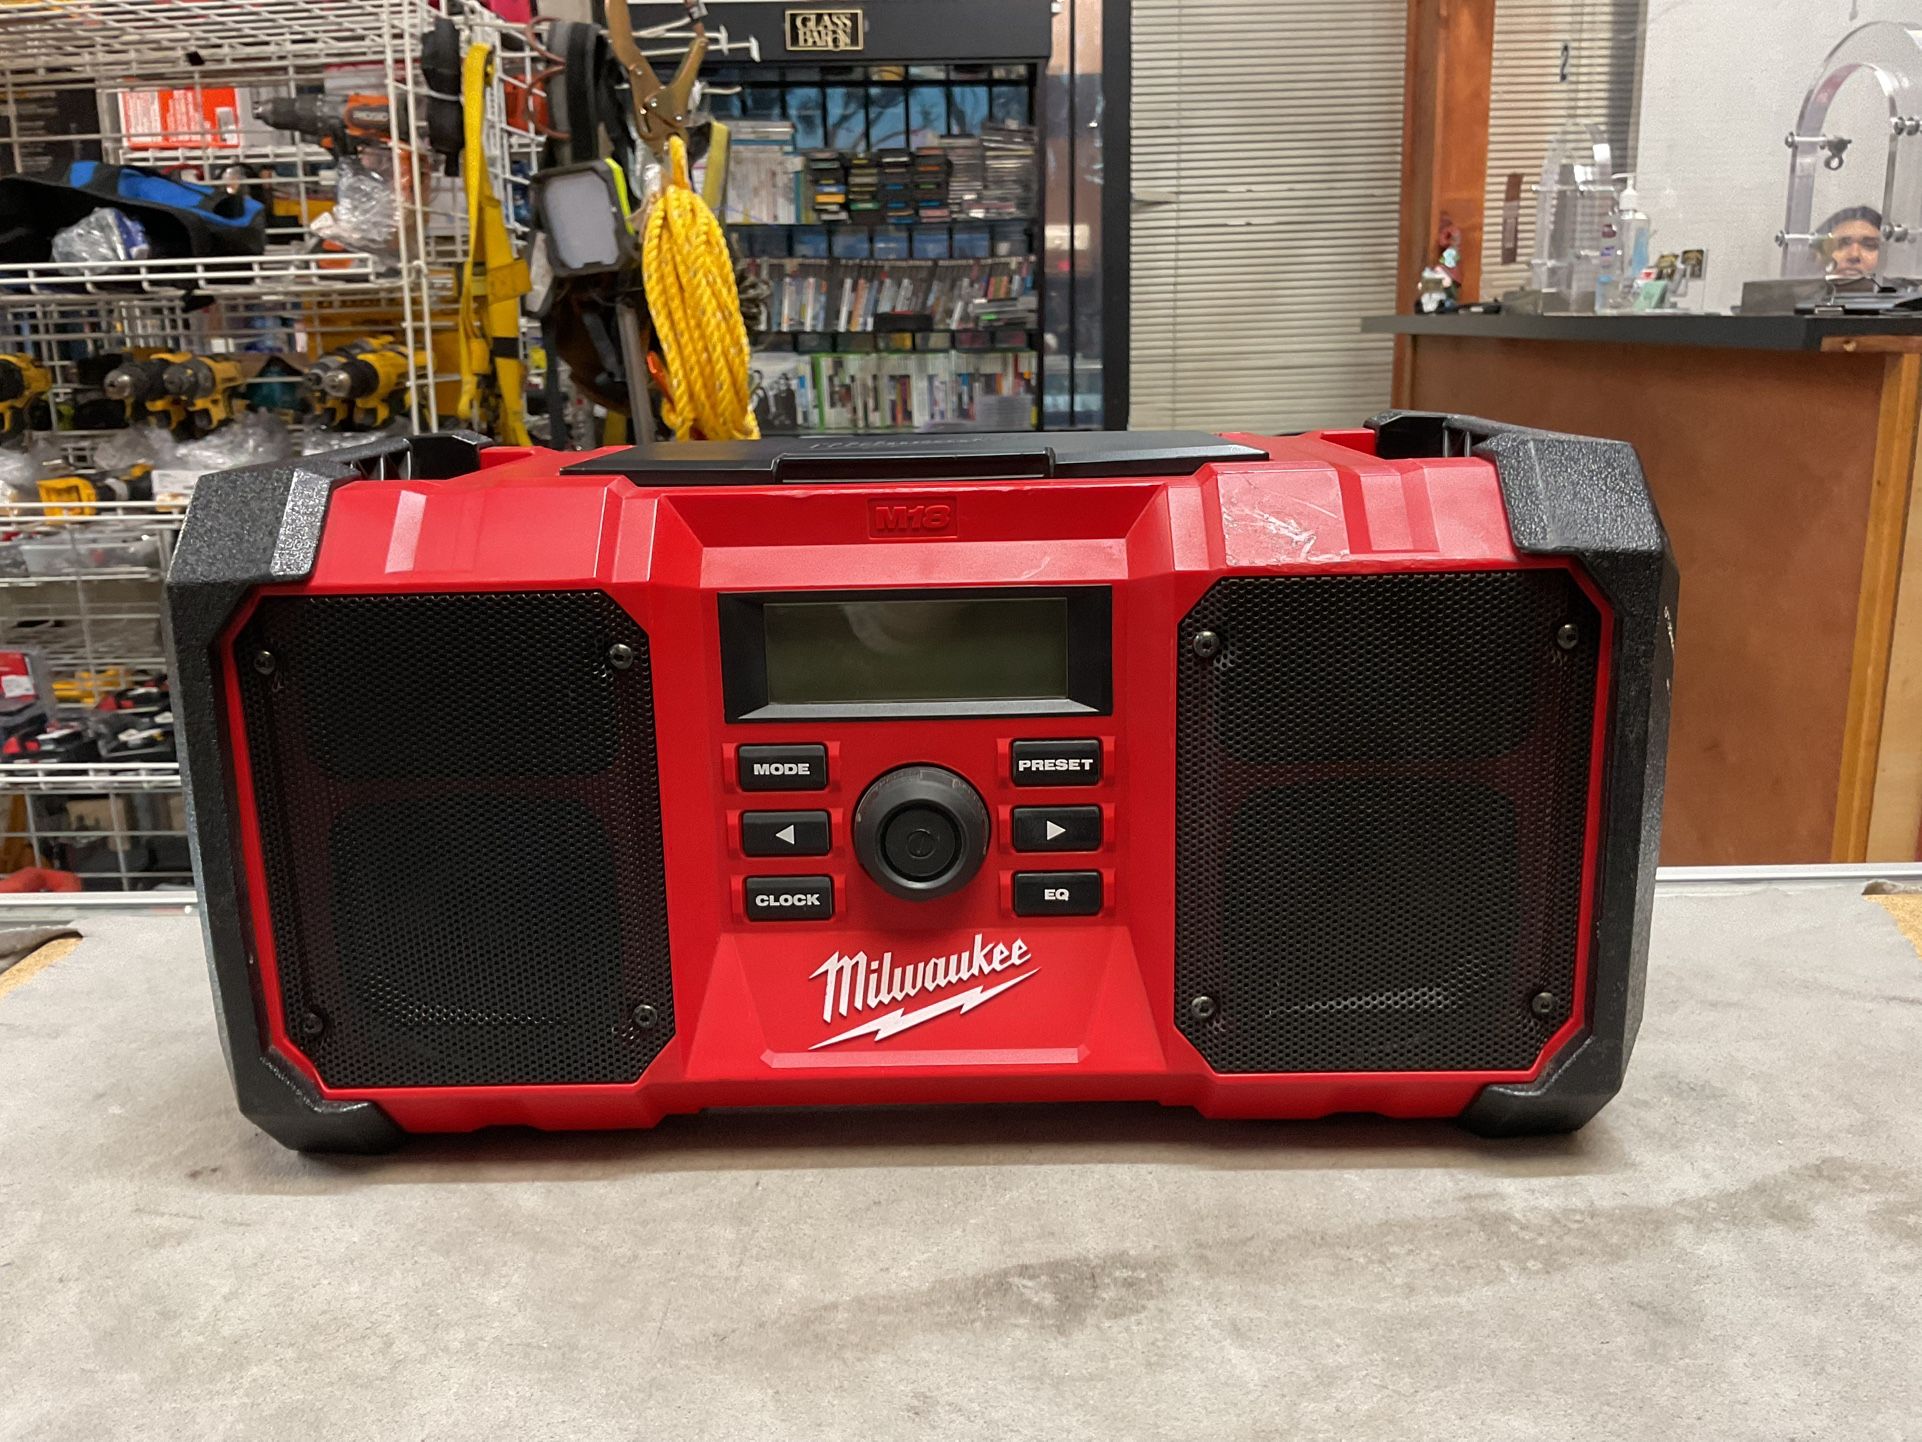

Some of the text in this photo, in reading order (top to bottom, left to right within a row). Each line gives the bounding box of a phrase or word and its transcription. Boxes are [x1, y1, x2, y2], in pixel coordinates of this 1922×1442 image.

[796, 13, 852, 32] GLASS
[798, 29, 851, 51] BARON
[875, 504, 951, 530] M18
[753, 763, 811, 776] MODE
[1018, 758, 1094, 772] PRESET
[755, 893, 821, 907] CLOCK
[1043, 888, 1070, 902] EQ
[808, 932, 1033, 1025] Milwaukee
